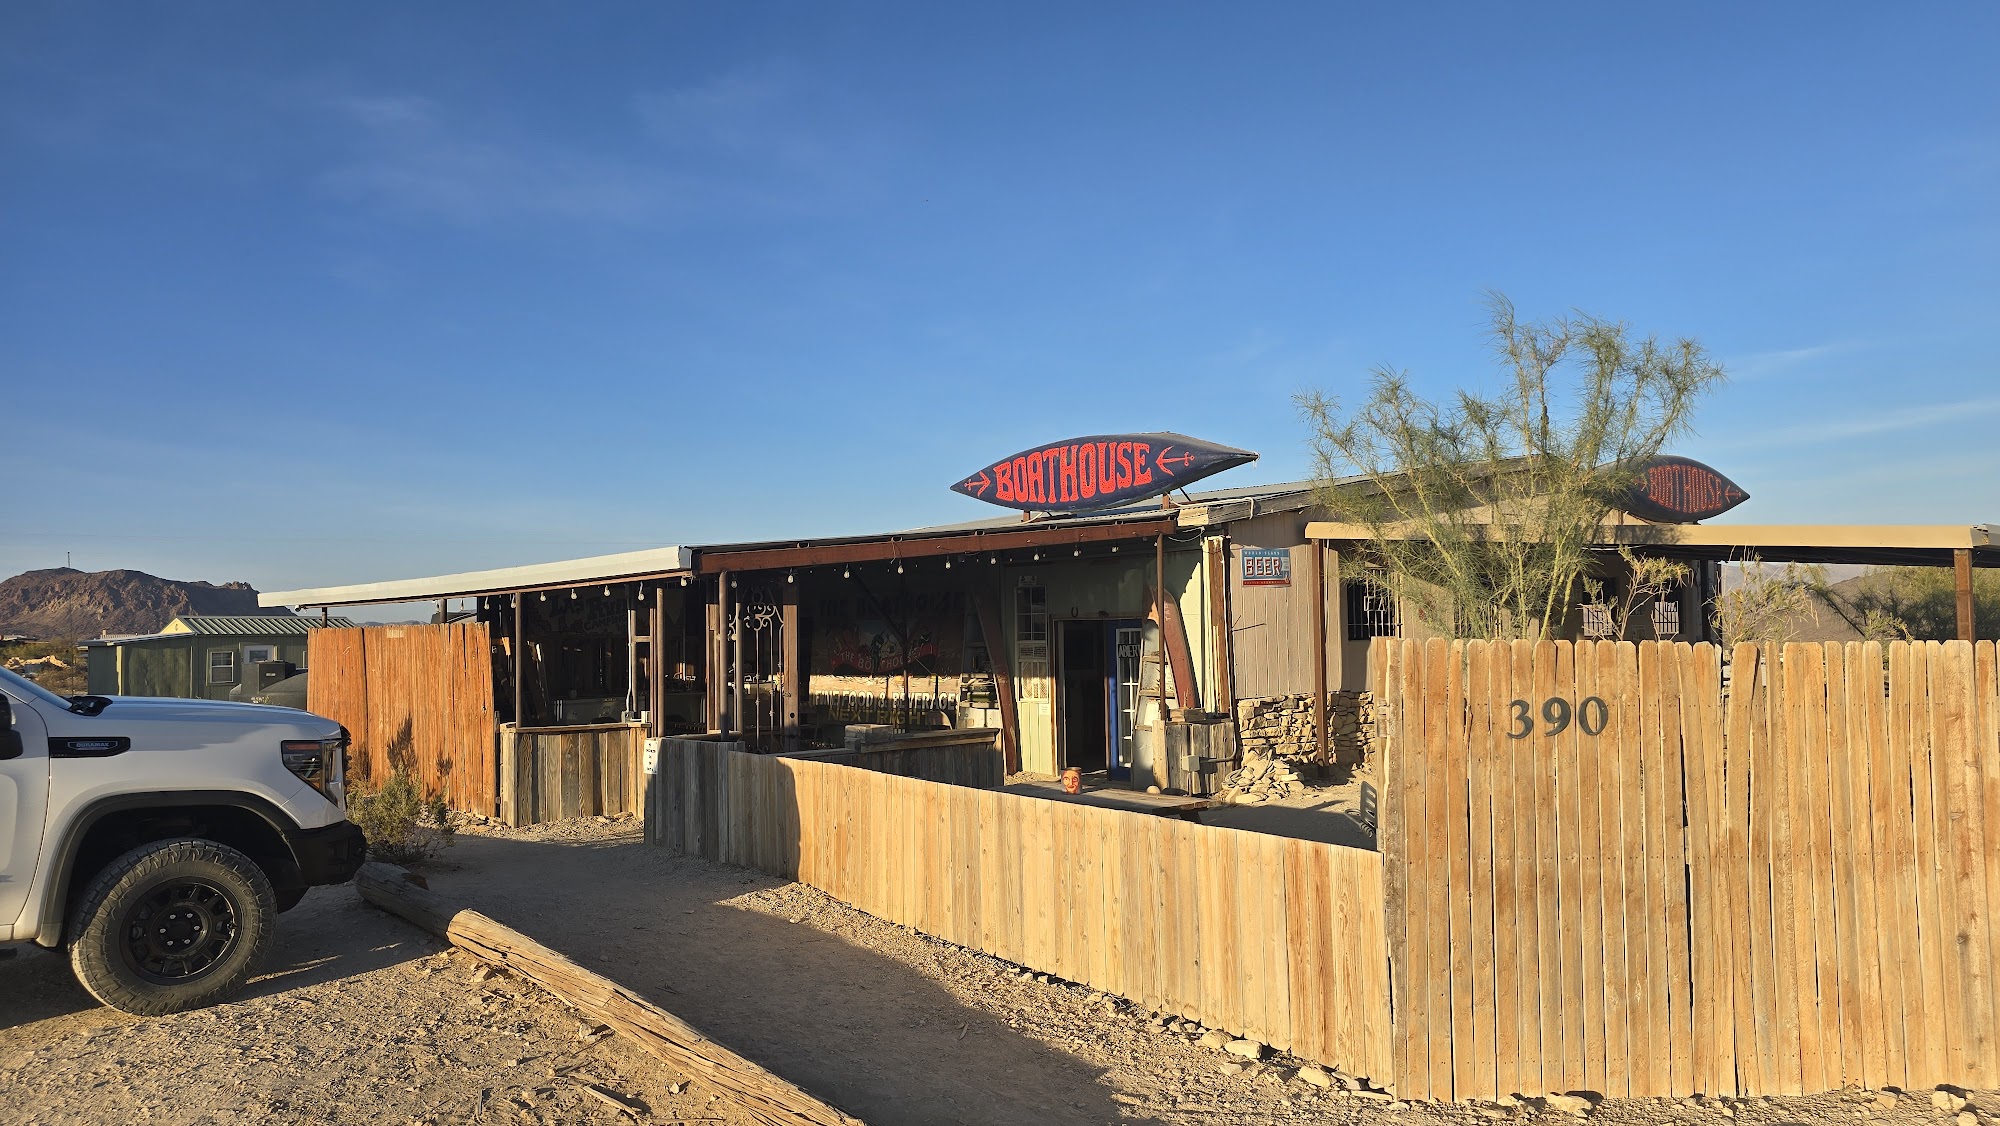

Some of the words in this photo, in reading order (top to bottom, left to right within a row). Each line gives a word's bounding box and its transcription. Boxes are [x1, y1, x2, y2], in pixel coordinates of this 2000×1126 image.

[993, 442, 1152, 504] BOATHOUSE
[1648, 464, 1722, 514] BOATHOUSE
[1244, 557, 1283, 577] BEER
[840, 651, 855, 663] THE
[815, 690, 840, 706] FINE
[842, 691, 873, 707] FOOD
[877, 692, 888, 708] &
[828, 708, 873, 723] NEXT
[1506, 696, 1609, 740] 390
